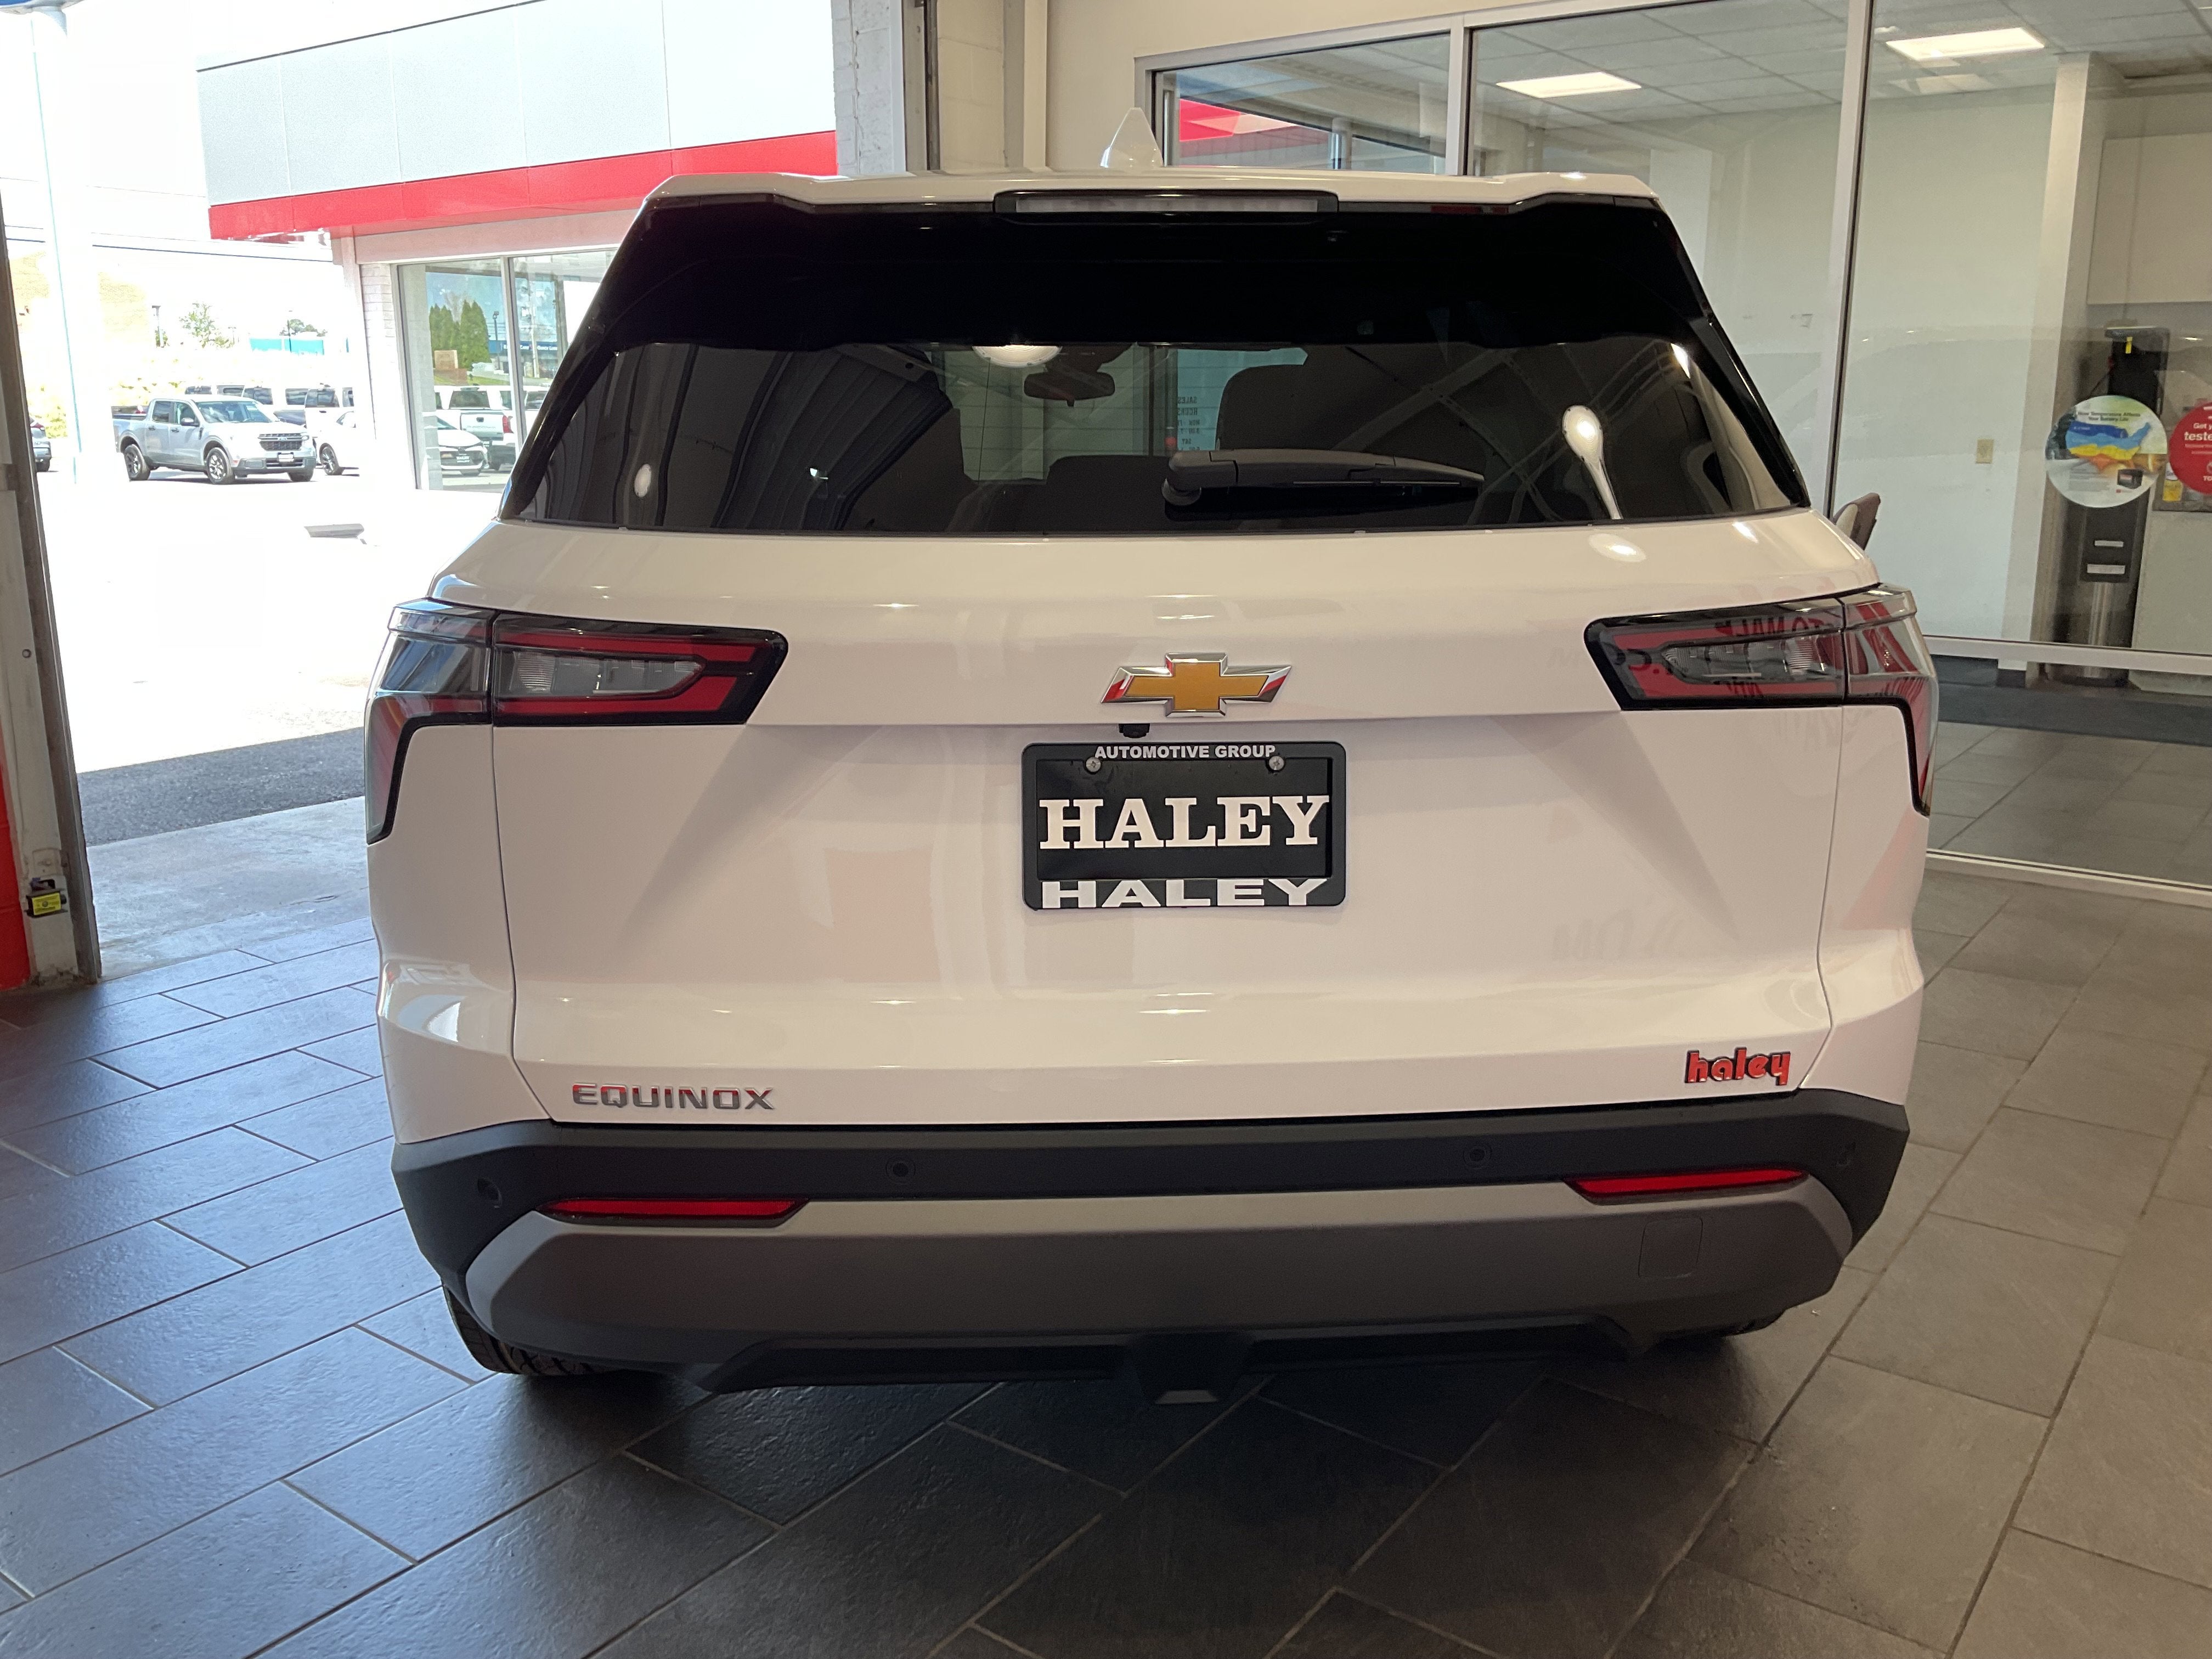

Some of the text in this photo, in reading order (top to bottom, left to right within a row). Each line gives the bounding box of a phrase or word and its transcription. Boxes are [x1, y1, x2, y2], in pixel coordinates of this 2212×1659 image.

[1094, 745, 1276, 759] AUTOMOTIVE GROUP
[1039, 795, 1329, 849] HALEY
[1042, 878, 1328, 909] HALEY
[1685, 1047, 1791, 1086] haley
[572, 1082, 775, 1110] EQUINOX
